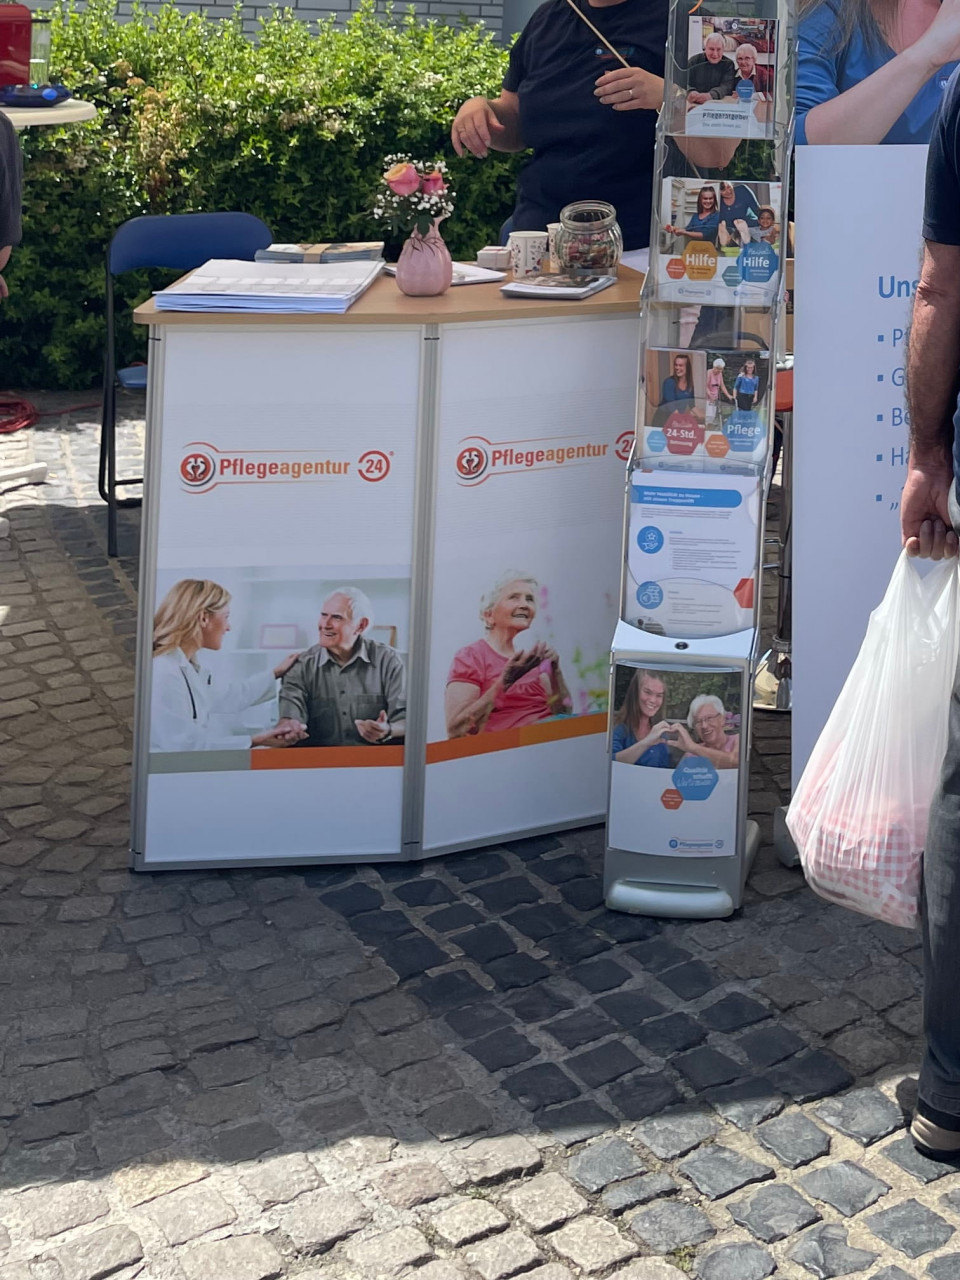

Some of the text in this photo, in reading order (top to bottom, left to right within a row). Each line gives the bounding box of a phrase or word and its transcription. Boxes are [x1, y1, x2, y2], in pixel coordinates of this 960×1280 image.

[685, 254, 716, 267] Hilfe
[743, 256, 770, 268] Hilfe
[666, 428, 697, 439] 24-Std.
[727, 424, 761, 437] Pflege
[491, 442, 609, 467] Pflegeagentur
[219, 458, 384, 479] Pflegeagentur 24
